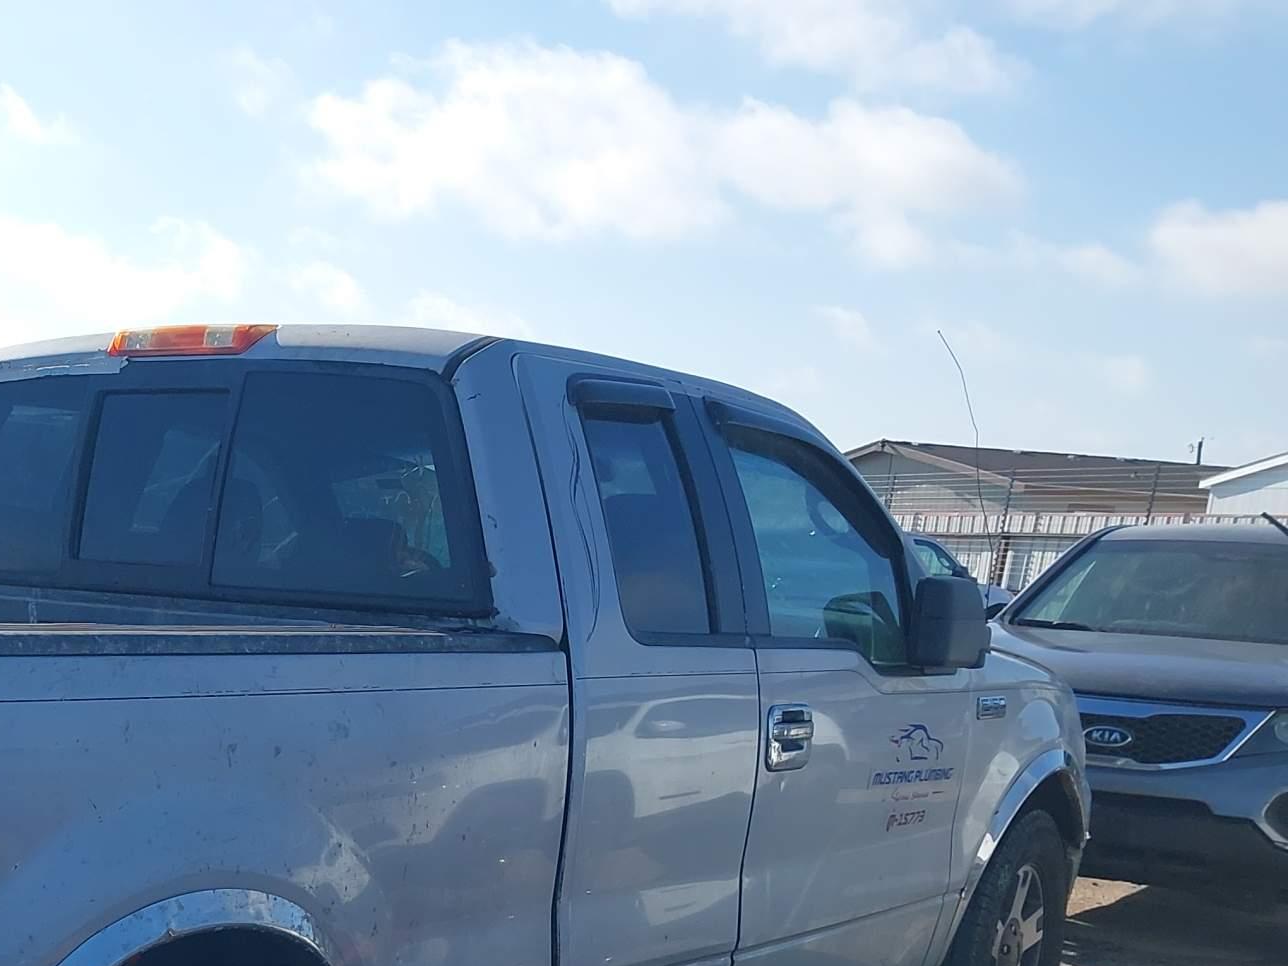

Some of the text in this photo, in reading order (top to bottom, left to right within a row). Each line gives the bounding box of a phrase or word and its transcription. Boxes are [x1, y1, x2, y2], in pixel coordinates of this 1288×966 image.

[1092, 730, 1122, 742] KIA
[872, 767, 954, 786] MUSTANG PLUMBING
